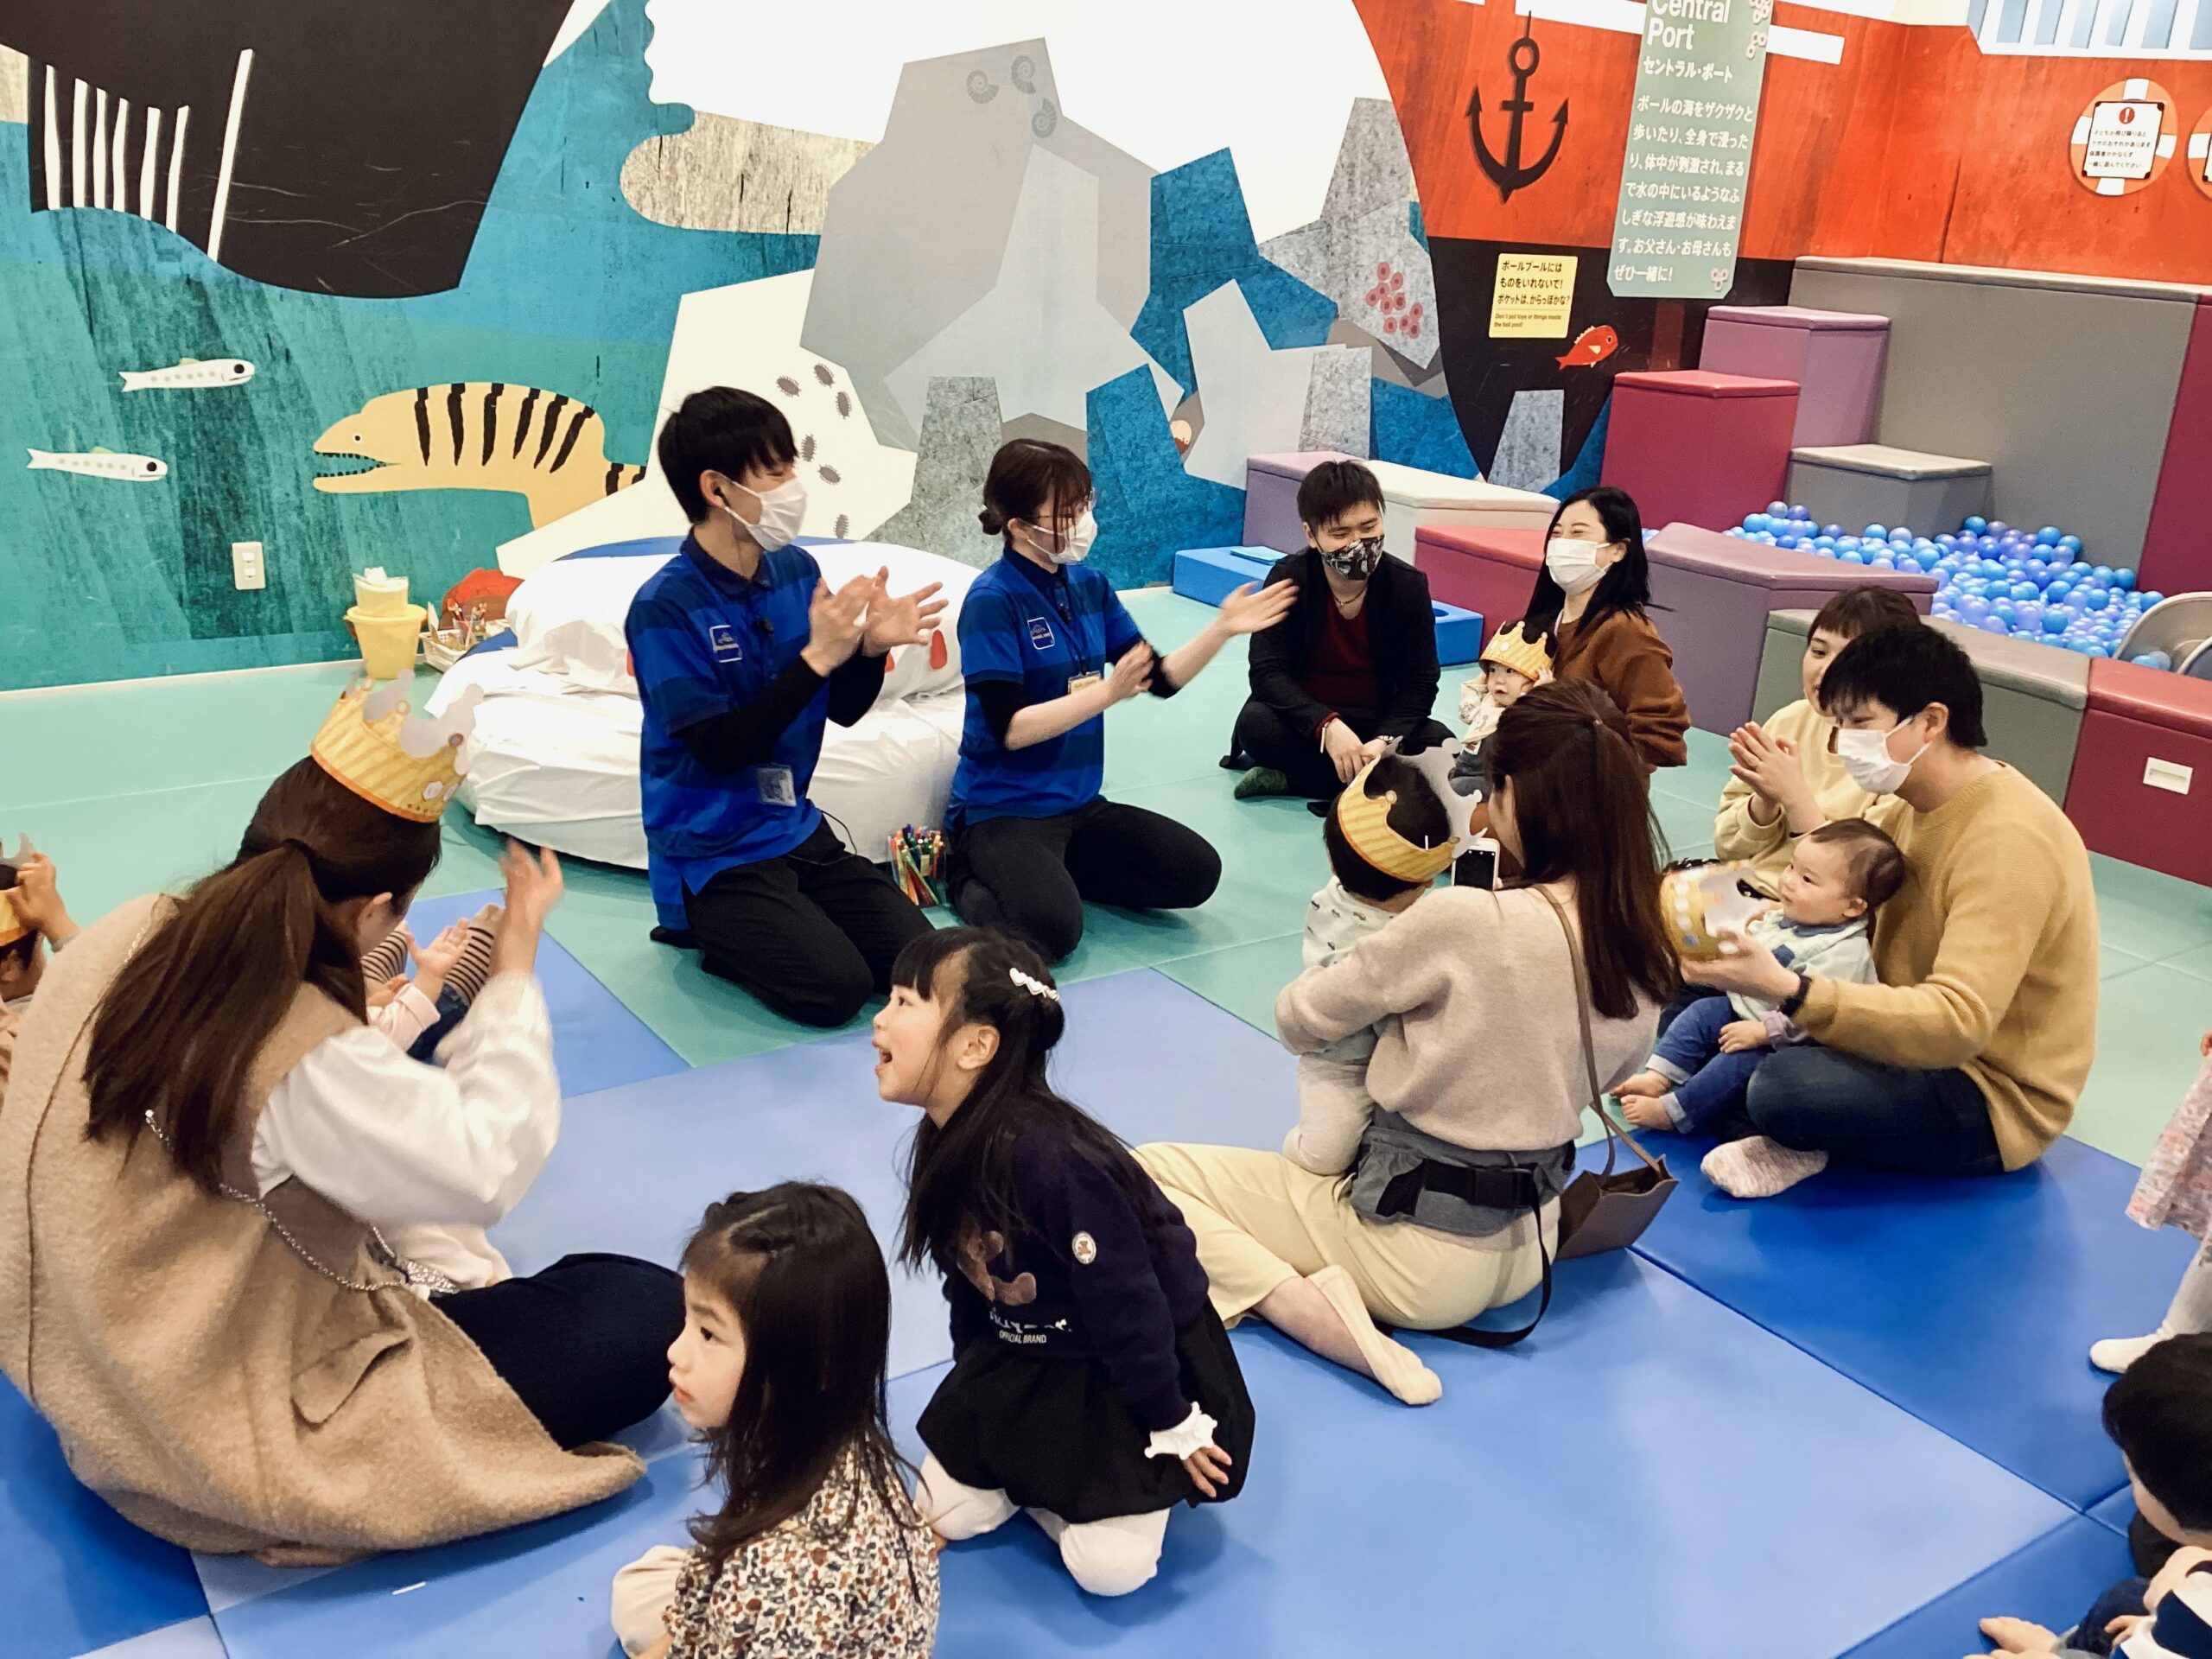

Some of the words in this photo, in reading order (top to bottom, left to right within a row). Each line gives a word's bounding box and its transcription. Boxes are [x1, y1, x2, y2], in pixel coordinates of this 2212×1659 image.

[1651, 0, 1731, 23] Central
[1647, 17, 1694, 50] Port
[1637, 94, 1754, 123] ボールの海をザクザクと
[1625, 181, 1740, 204] で水の中にいるようなふ
[999, 1330, 1022, 1344] OFFICIAL
[1023, 1333, 1047, 1344] BRAND
